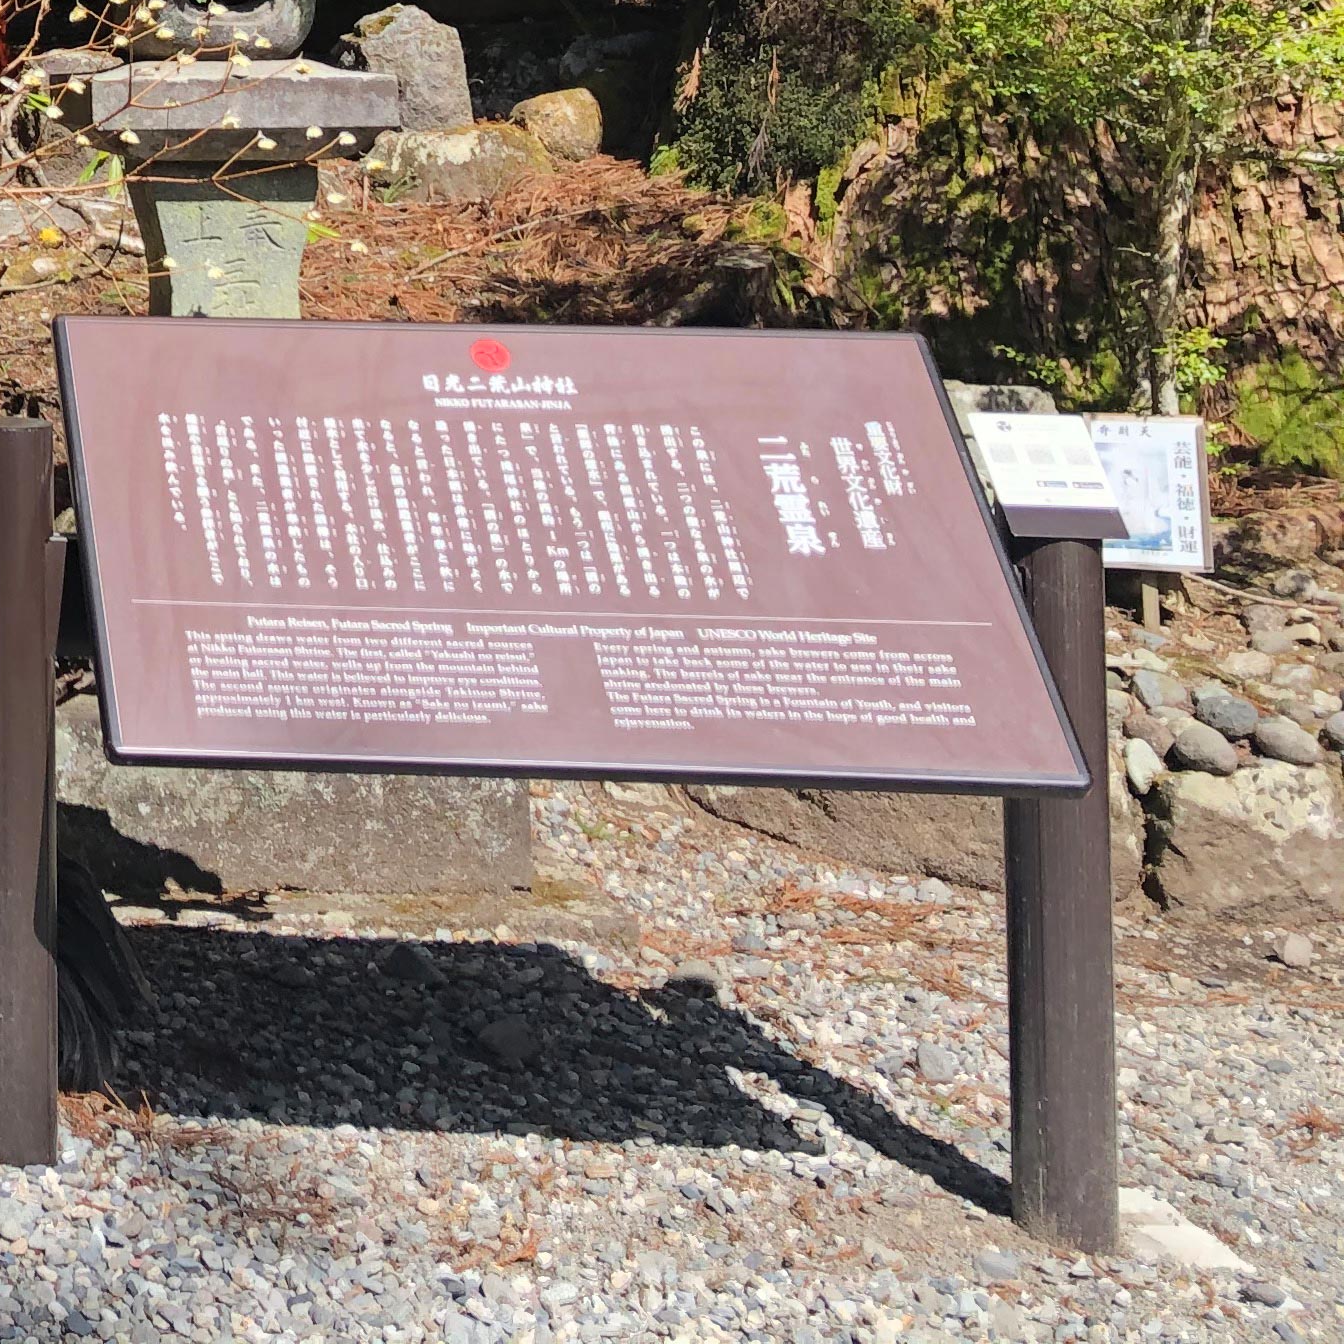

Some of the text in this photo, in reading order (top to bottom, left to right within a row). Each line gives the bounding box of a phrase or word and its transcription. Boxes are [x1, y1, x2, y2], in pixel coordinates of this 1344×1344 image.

[422, 373, 579, 396] 日光二荒山神社
[433, 397, 470, 408] NIKKO
[864, 421, 904, 497] 重要文化財
[757, 436, 827, 557] 二荒霊泉
[829, 437, 888, 550] 世界文化遺産
[246, 615, 453, 635] Futara Reisen, Futara Sacred Spring
[465, 621, 684, 642] Important Cultural Property of Japan
[184, 629, 533, 650] This spring draws water from two different sacred sources
[696, 627, 877, 646] UNESCO World Heritage Site
[186, 643, 198, 653] at
[200, 641, 236, 654] Nikko
[237, 642, 293, 656] Futarasan
[335, 646, 358, 658] The
[359, 647, 386, 659] first,
[388, 647, 422, 660] called
[477, 653, 493, 661] no
[592, 641, 953, 662] Every spring and autumn, sake brewers come from across
[188, 654, 539, 677] or healing sacred water, wells up from the mountain behind
[596, 653, 957, 675] Japan to take back some of the water to use in their sake
[190, 666, 209, 679] the
[211, 668, 240, 679] main
[268, 668, 294, 681] This
[296, 671, 328, 682] water
[330, 671, 342, 682] is
[342, 671, 391, 683] believed
[392, 673, 406, 683] to
[407, 673, 455, 686] improve
[456, 676, 477, 686] eye
[600, 665, 961, 687] making. The barrels of sake near the entrance of the main
[603, 678, 641, 690] shrine
[712, 681, 729, 694] by
[731, 682, 764, 694] these
[192, 678, 216, 691] The
[220, 681, 263, 692] second
[267, 683, 308, 693] source
[312, 684, 376, 696] originates
[380, 685, 441, 698] alongside
[194, 693, 281, 706] approximately
[294, 694, 315, 706] km
[352, 696, 396, 708] Known
[398, 696, 413, 709] as
[453, 701, 469, 710] no
[520, 701, 548, 712] sake
[605, 690, 629, 702] The
[631, 691, 672, 704] Futara
[672, 693, 714, 705] Sacred
[714, 693, 758, 708] Spring
[758, 695, 771, 706] is
[772, 698, 781, 707] a
[782, 695, 838, 708] Fountain
[839, 698, 853, 709] of
[897, 700, 922, 711] and
[923, 701, 971, 713] visitors
[196, 703, 252, 717] produced
[254, 705, 288, 719] using
[289, 707, 312, 718] this
[314, 709, 347, 719] water
[349, 709, 361, 720] is
[363, 710, 431, 724] particularly
[609, 705, 642, 715] come
[643, 704, 671, 716] here
[673, 706, 687, 716] to
[689, 706, 724, 718] drink
[725, 705, 742, 718] its
[743, 706, 785, 720] waters
[787, 709, 801, 720] in
[802, 709, 823, 721] the
[859, 711, 873, 723] of
[875, 712, 907, 725] good
[908, 713, 949, 725] health
[951, 715, 976, 726] and
